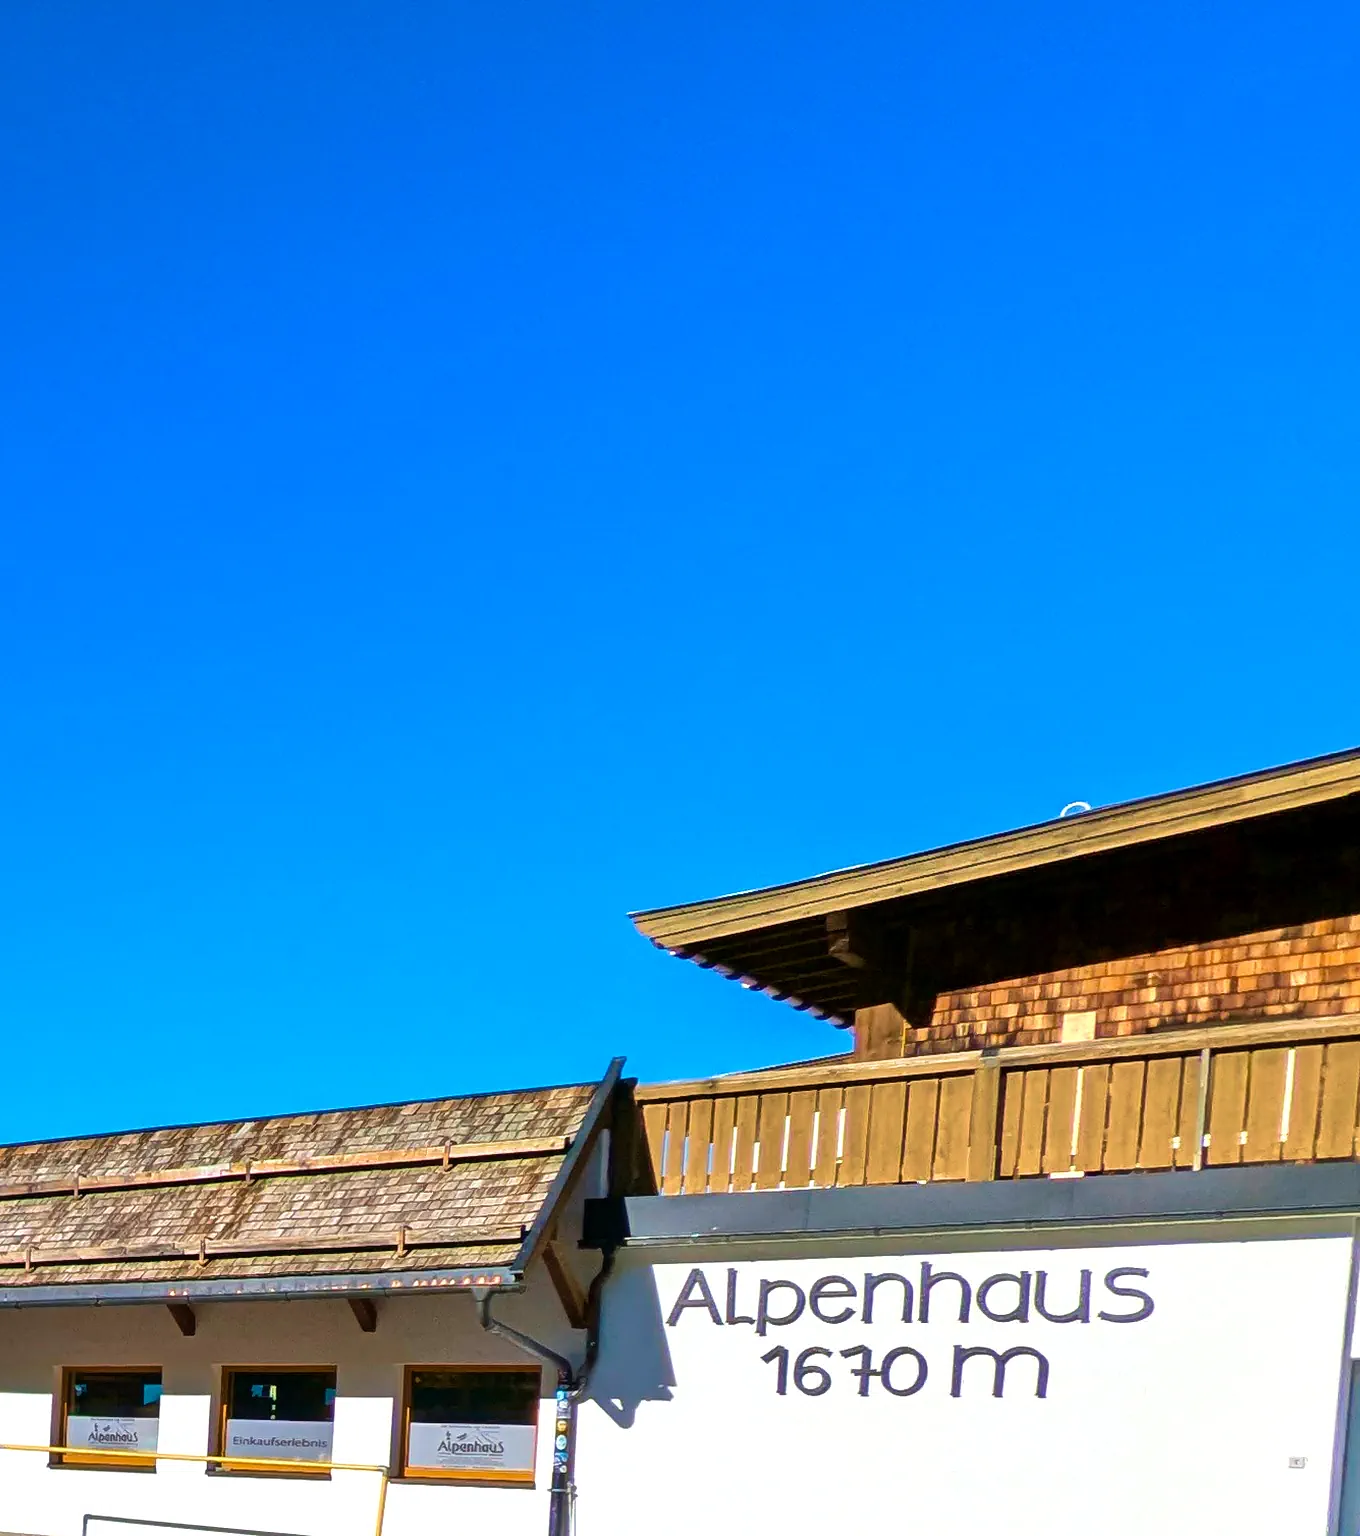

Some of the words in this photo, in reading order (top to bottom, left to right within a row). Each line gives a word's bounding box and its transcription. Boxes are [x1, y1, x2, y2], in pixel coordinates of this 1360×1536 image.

[761, 1345, 929, 1397] 1670
[951, 1344, 1050, 1399] m
[88, 1431, 138, 1443] Alpenhaus
[232, 1436, 328, 1448] Einkaufserlebnis
[437, 1440, 505, 1454] Alpenhaus
